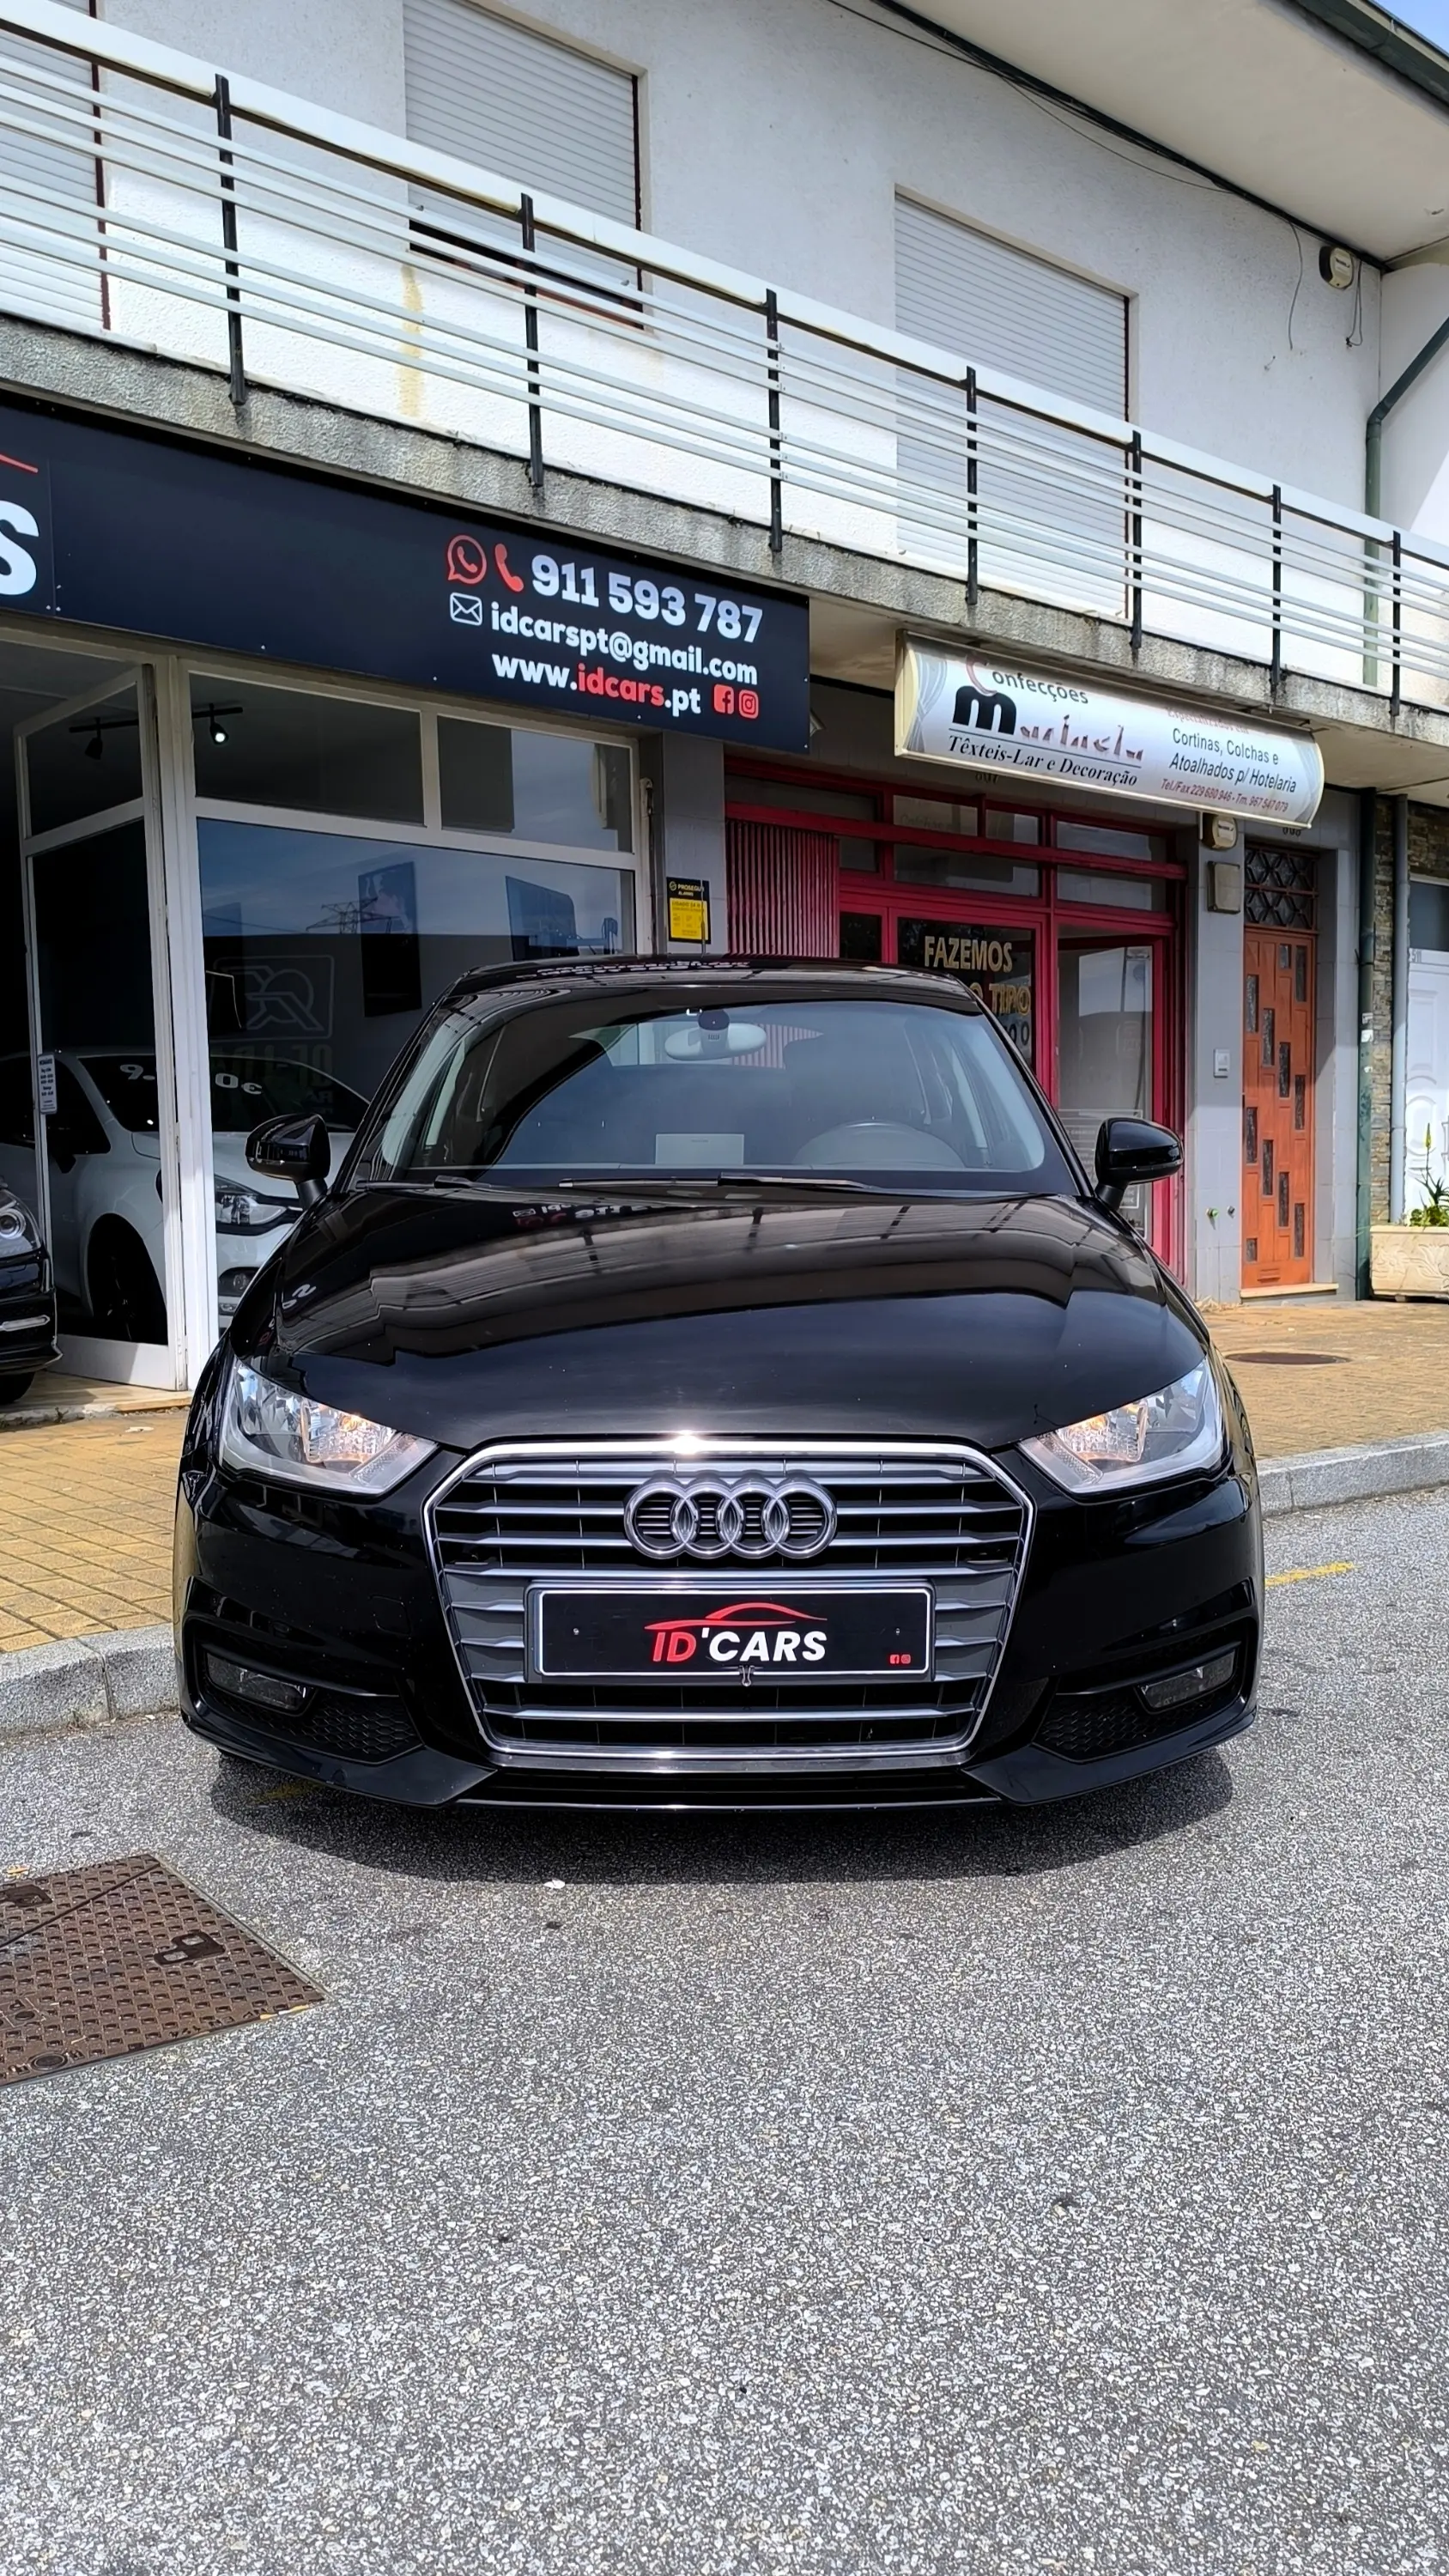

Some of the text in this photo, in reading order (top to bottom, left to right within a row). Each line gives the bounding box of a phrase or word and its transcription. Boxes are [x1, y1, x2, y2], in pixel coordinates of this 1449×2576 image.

[530, 554, 763, 643] 911 593 787
[491, 601, 758, 685] idcarspt@gmail.com
[492, 653, 701, 716] www.idcars.pt
[949, 735, 1138, 787] Têxteis-Lar e Decoração
[1173, 727, 1279, 765] Cortinas, Colchas e
[1169, 752, 1297, 793] Atoalhados p/ Hotelaria
[925, 935, 1013, 973] FAZEMOS
[989, 982, 1031, 1016] TIPO
[652, 1626, 828, 1662] ID'CARS
